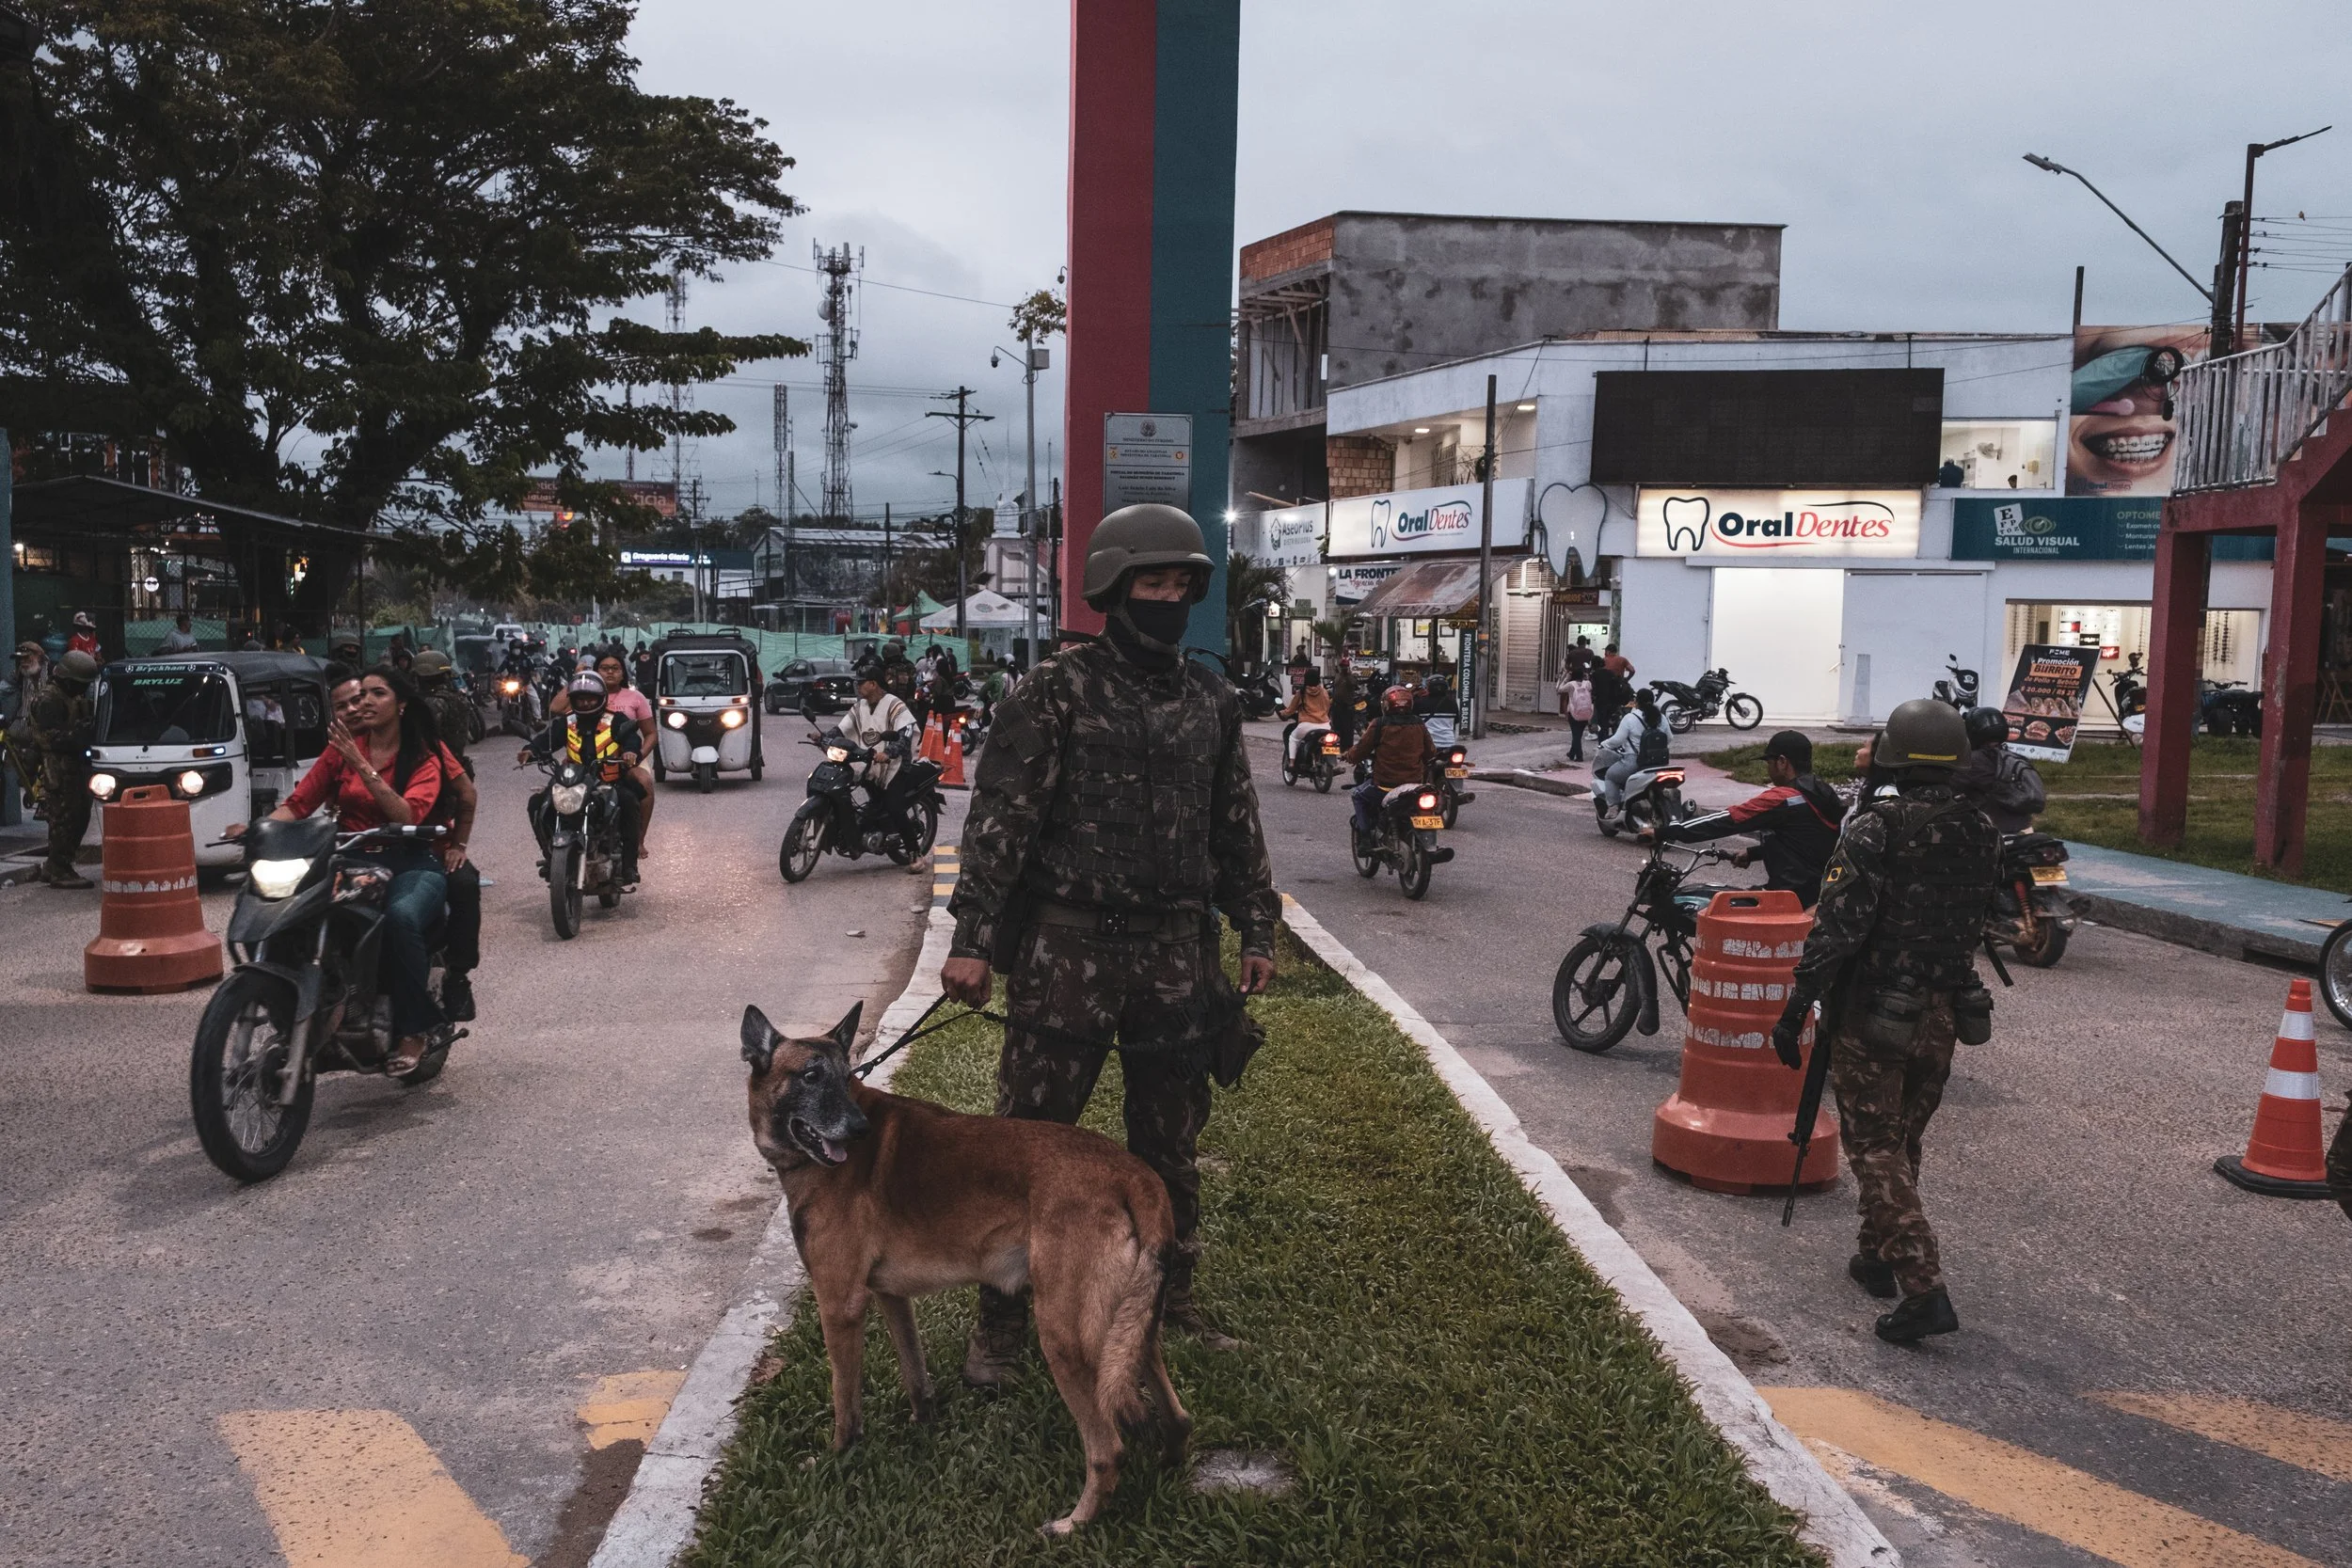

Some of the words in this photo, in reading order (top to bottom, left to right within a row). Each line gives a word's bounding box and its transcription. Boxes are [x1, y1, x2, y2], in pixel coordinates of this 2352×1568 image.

[2117, 511, 2161, 520] OPTOME
[1994, 536, 2034, 546] SALUD
[2037, 536, 2080, 546] VISUAL
[1339, 568, 1352, 579] LA
[1355, 567, 1402, 579] FRONTE
[1463, 633, 1471, 668] FRONTERA
[1489, 607, 1500, 698] EXCHANGE
[2037, 657, 2079, 666] Promoción
[2033, 664, 2077, 675] BURRITO
[1462, 669, 1470, 705] COLOMBIA
[1460, 706, 1469, 730] BRASIL
